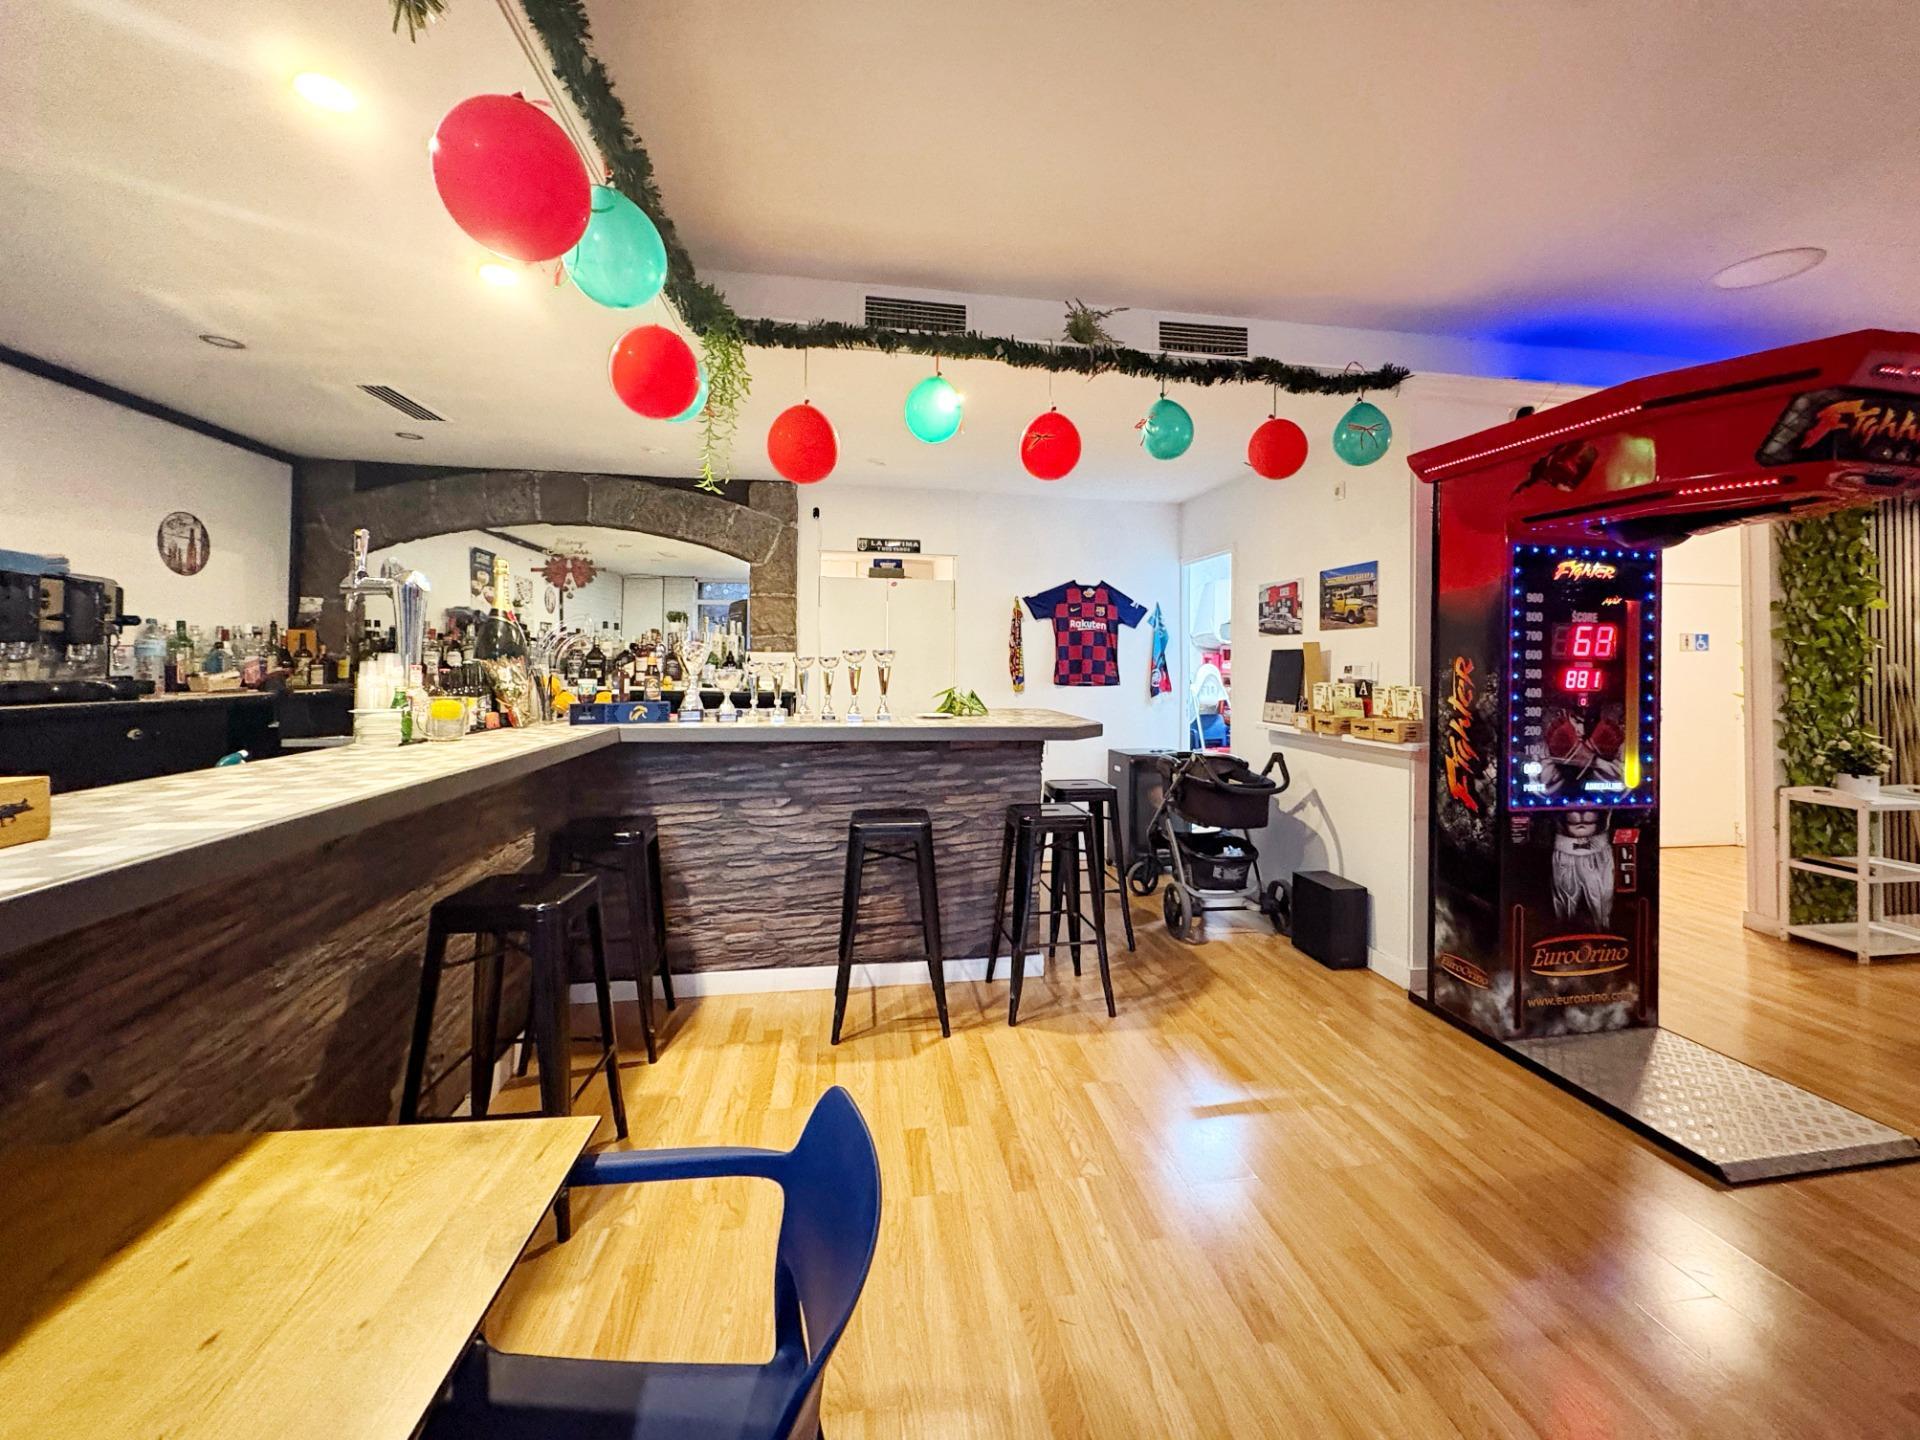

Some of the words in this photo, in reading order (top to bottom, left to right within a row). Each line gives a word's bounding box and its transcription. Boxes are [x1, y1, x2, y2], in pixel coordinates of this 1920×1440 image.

[1526, 592, 1544, 603] 900
[1526, 611, 1544, 622] 800
[1571, 611, 1599, 623] SCORE
[1069, 619, 1107, 631] Rakuten
[1525, 630, 1543, 641] 700
[1573, 625, 1614, 657] 68
[1525, 650, 1543, 660] 600
[1525, 669, 1542, 679] 500
[1565, 670, 1601, 689] 881
[1524, 688, 1542, 698] 400
[1524, 707, 1542, 717] 300
[1524, 726, 1541, 736] 200
[1524, 745, 1541, 755] 100
